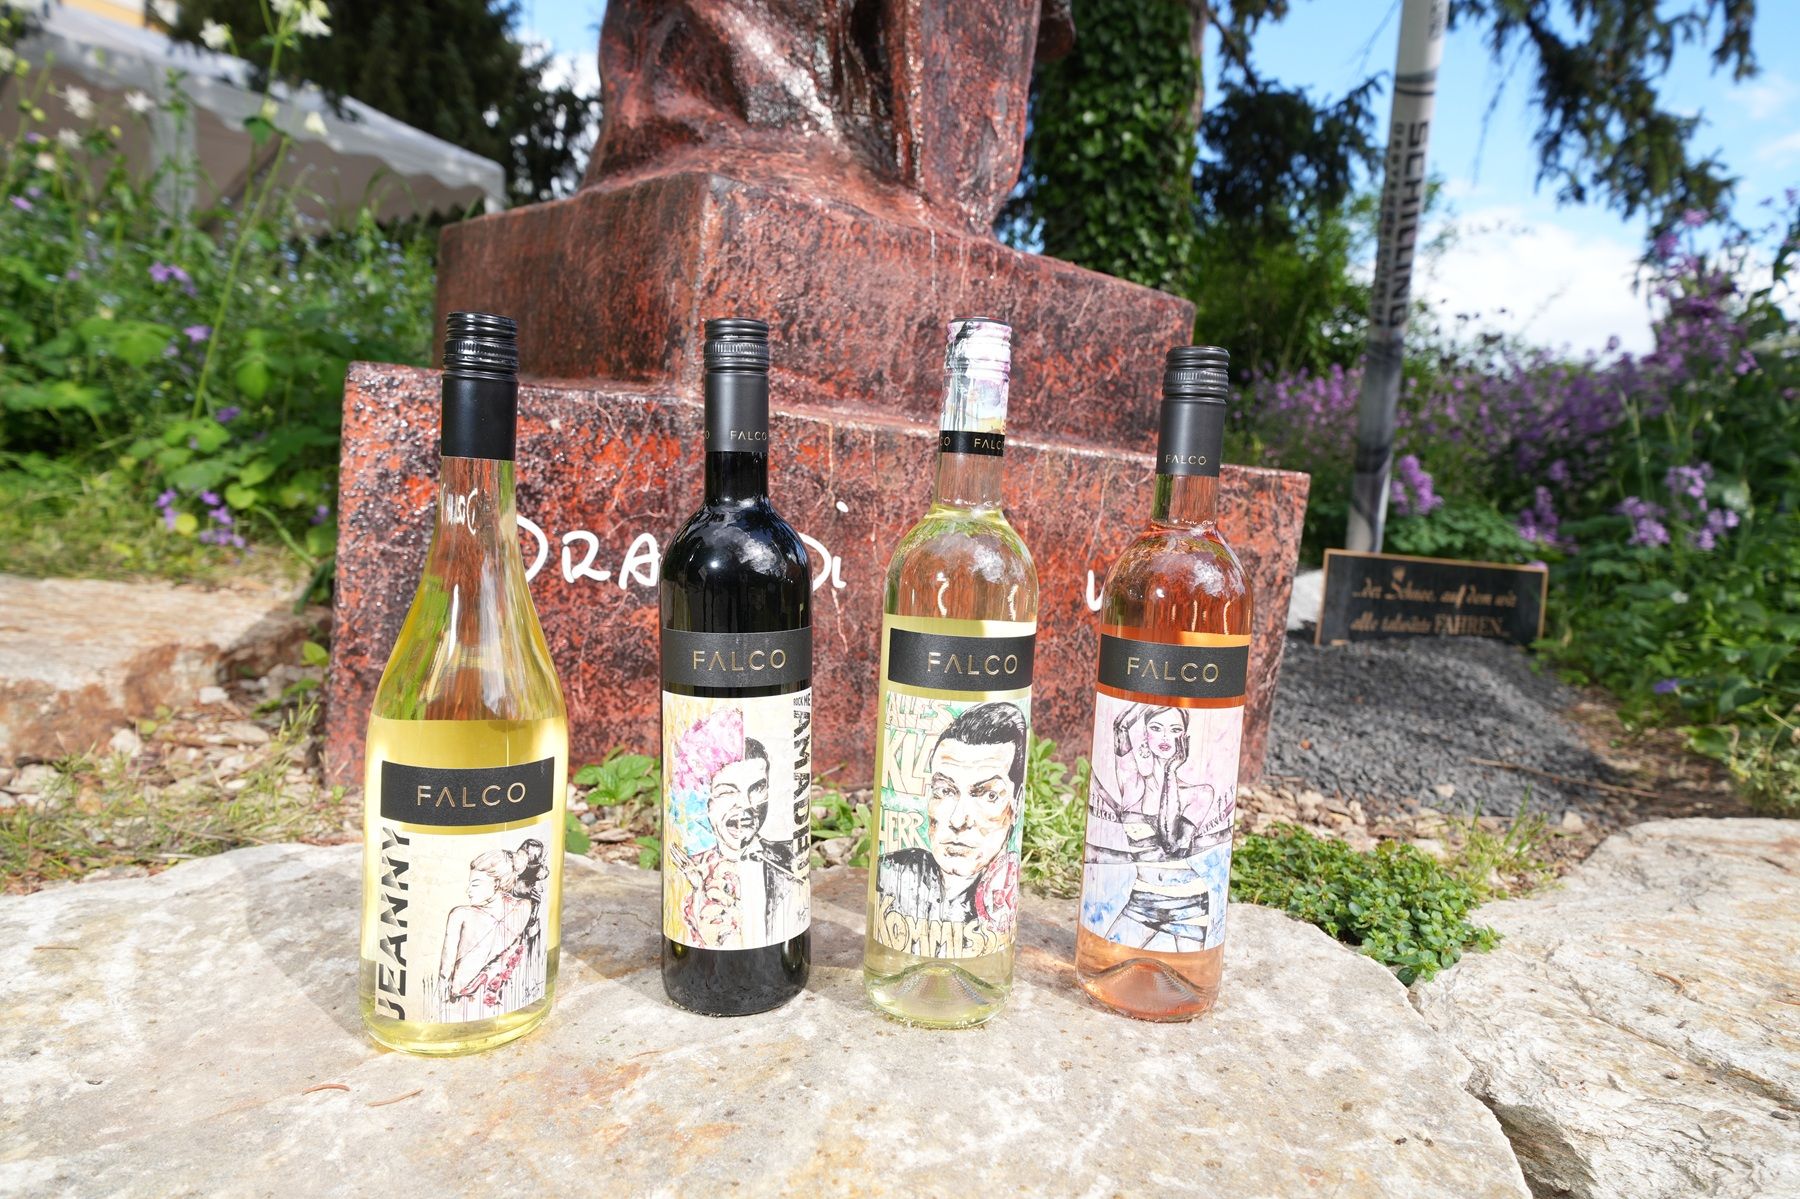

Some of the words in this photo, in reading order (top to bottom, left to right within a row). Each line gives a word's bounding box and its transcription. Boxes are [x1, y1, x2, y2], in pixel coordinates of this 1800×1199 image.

[1389, 120, 1429, 327] SCHILLING
[730, 430, 767, 441] FALCO
[974, 438, 1005, 450] FALC
[1164, 454, 1207, 466] FALCO
[693, 648, 787, 672] FALCO
[927, 651, 1018, 676] FALCO
[1127, 656, 1219, 683] FALCO
[416, 782, 526, 808] FALCO
[378, 826, 410, 1021] JEANNY
